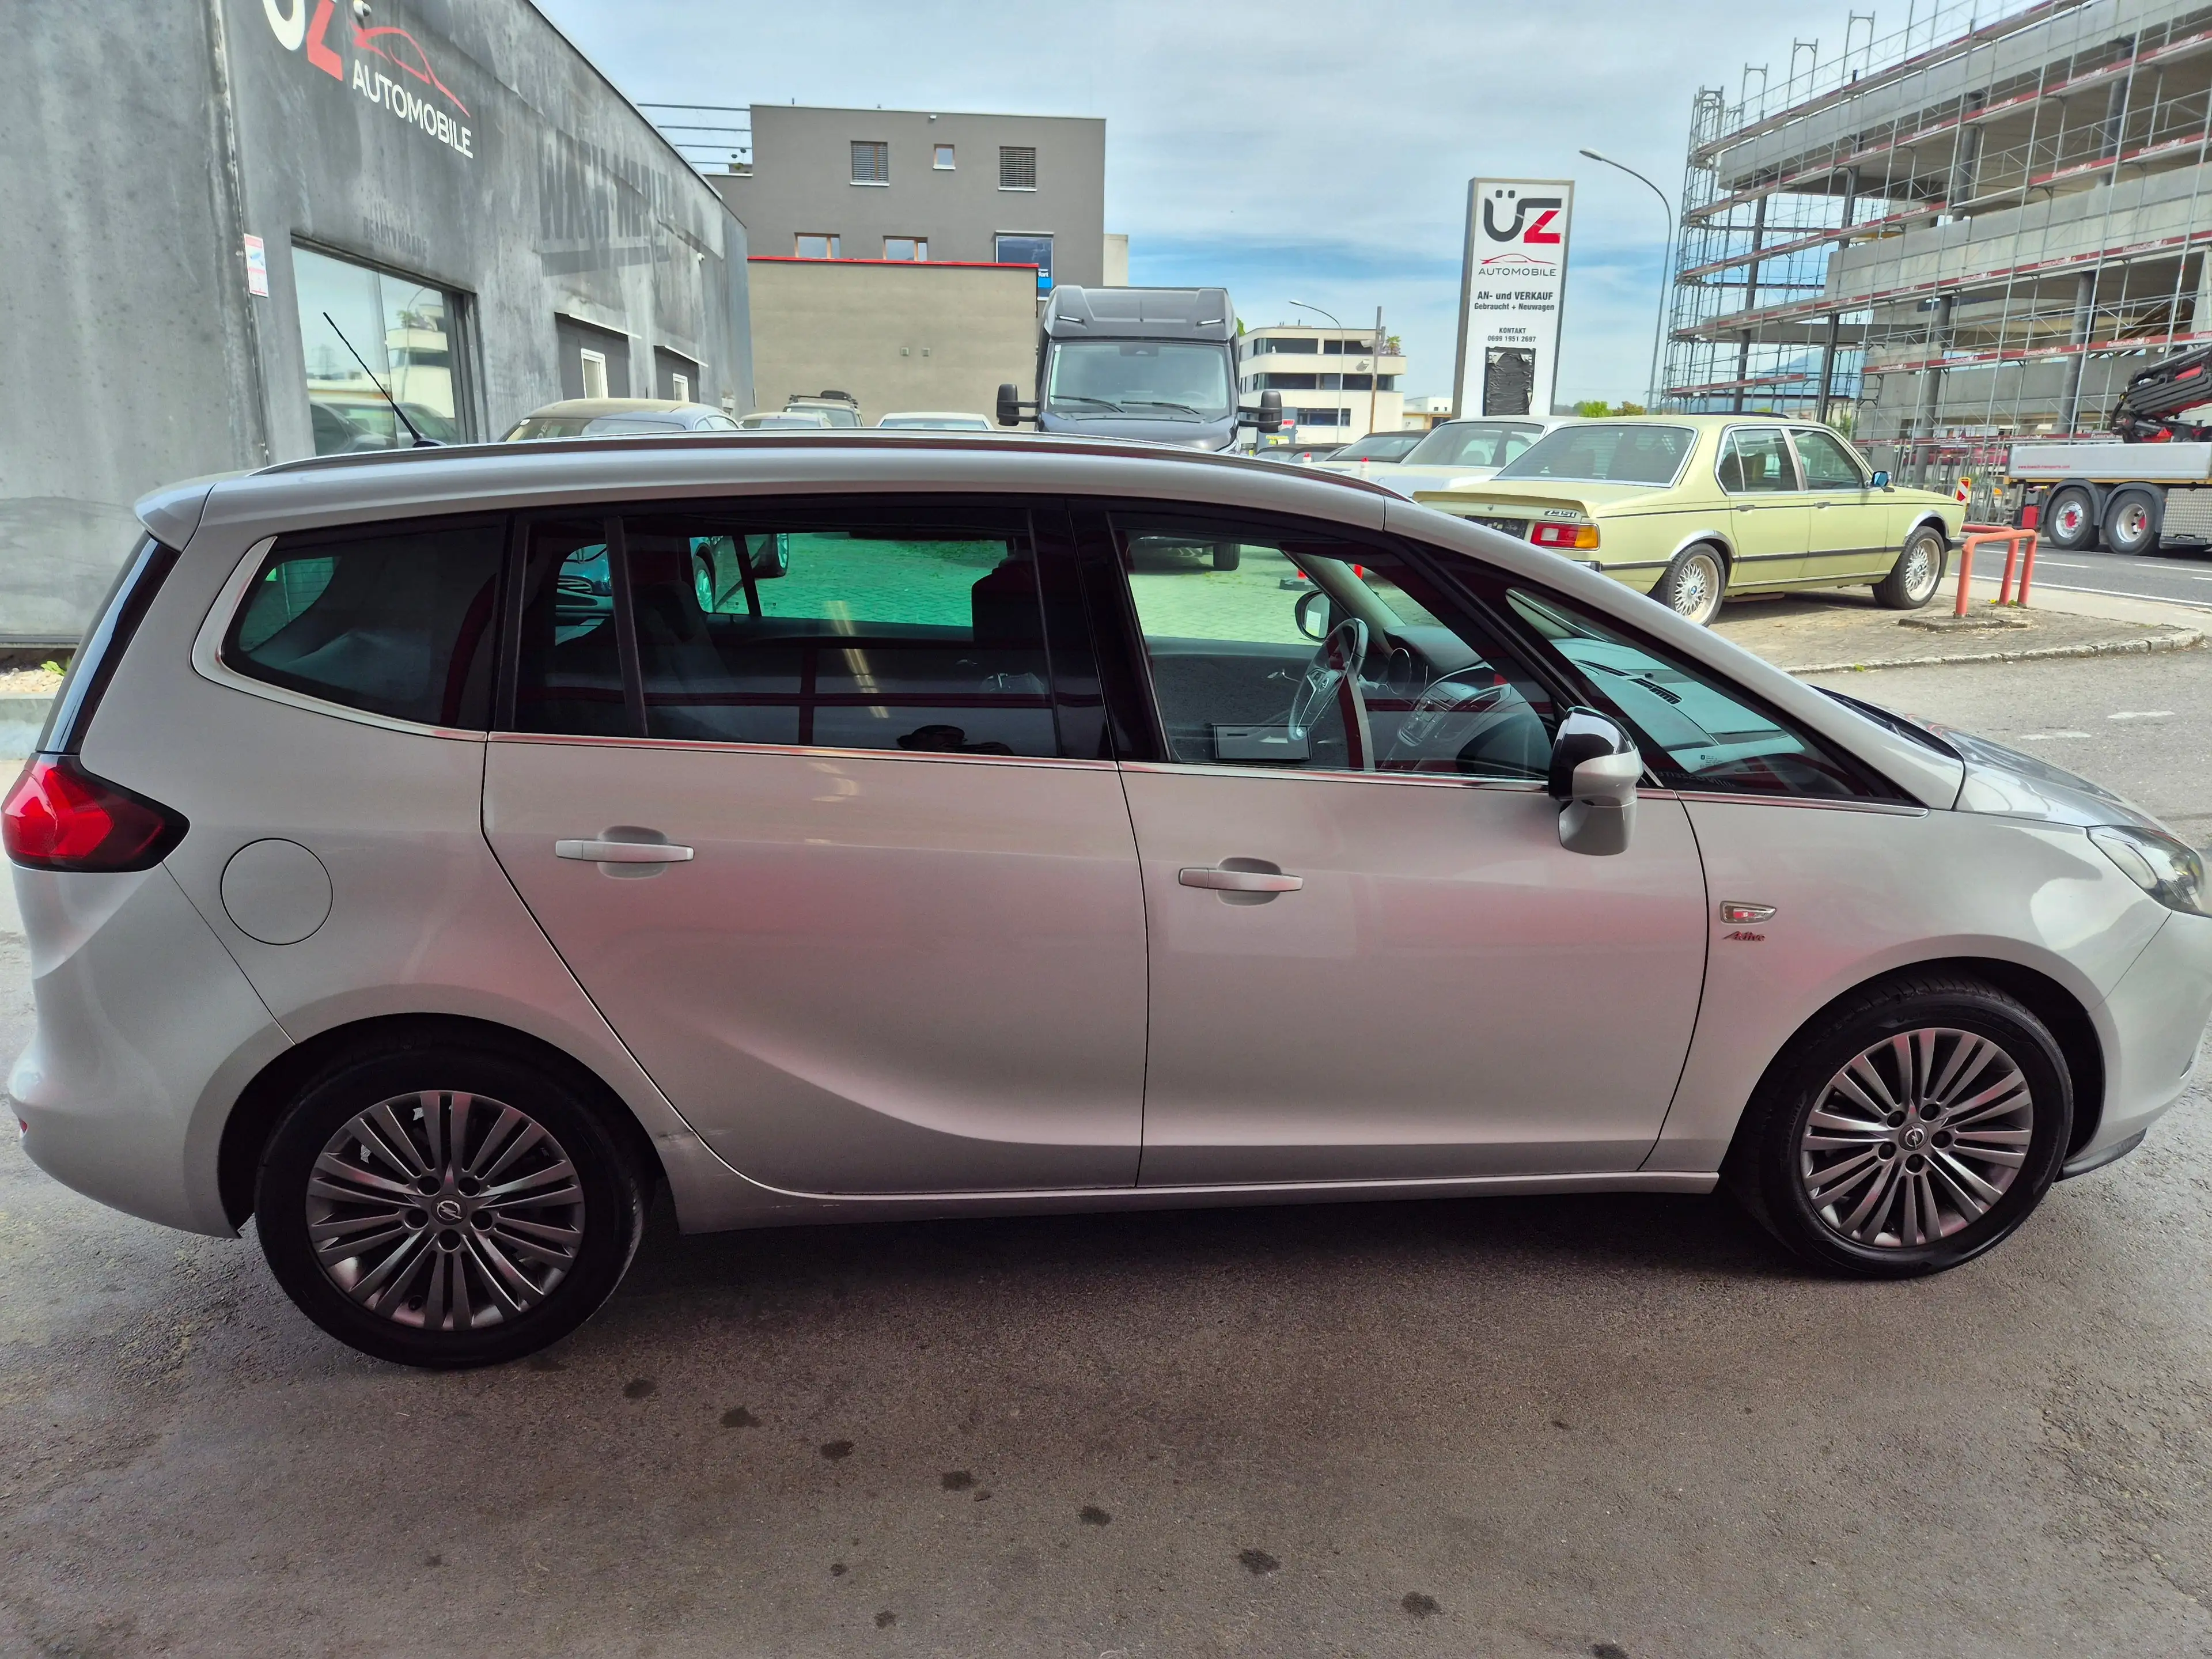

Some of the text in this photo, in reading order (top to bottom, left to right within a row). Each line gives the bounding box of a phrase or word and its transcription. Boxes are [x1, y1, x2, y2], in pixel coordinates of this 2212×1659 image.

[353, 59, 474, 158] AUTOMOBILE
[1484, 190, 1562, 244] ÜZ
[1478, 267, 1557, 276] AUTOMOBILE
[1477, 291, 1554, 300] AN- und VERKAUF
[1518, 303, 1555, 312] Neuwagen
